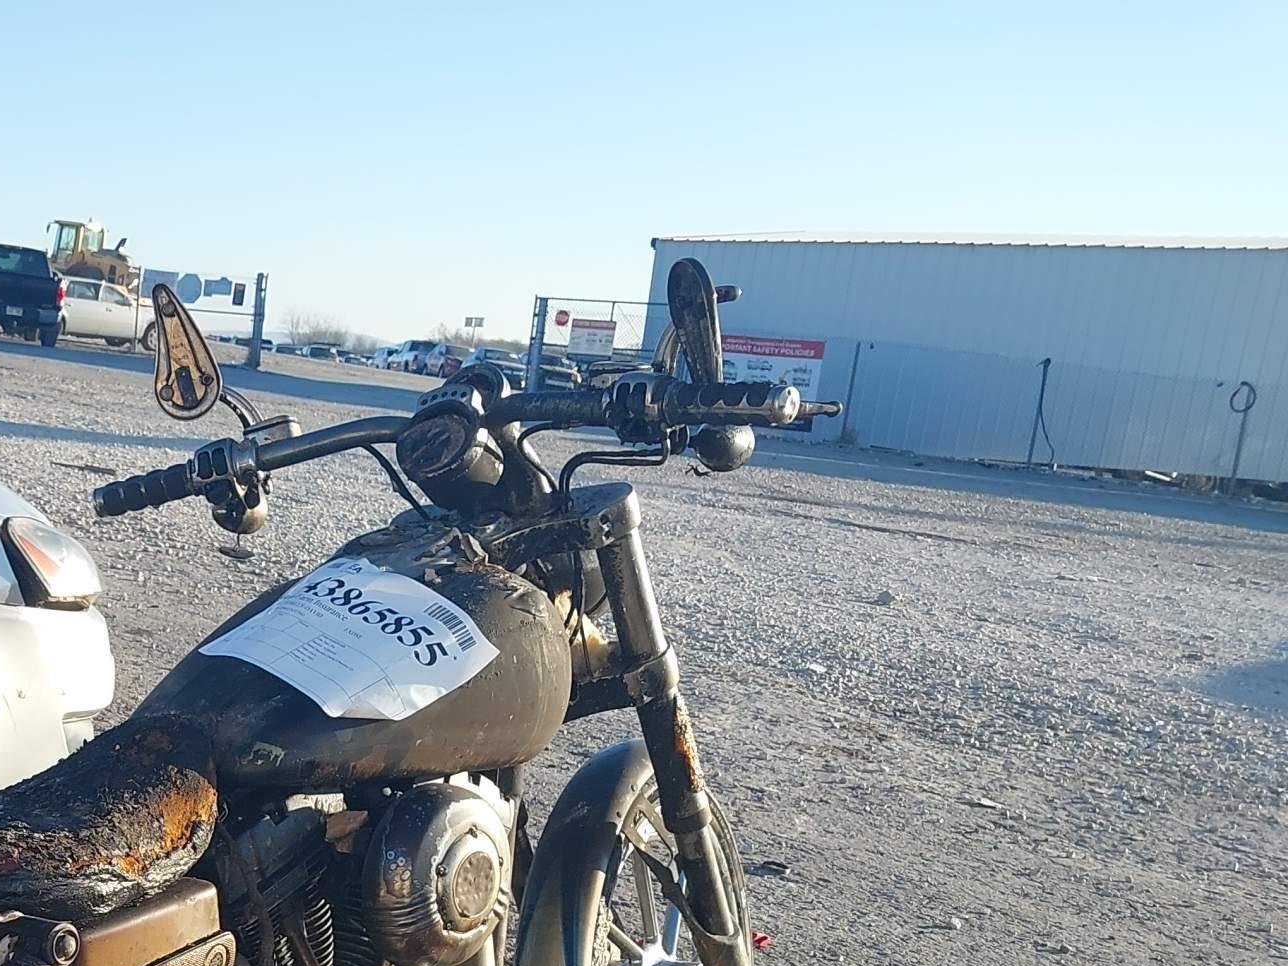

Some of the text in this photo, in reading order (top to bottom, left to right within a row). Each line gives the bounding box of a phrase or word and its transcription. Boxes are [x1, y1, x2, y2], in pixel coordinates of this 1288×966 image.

[722, 344, 815, 357] ORTANT SAFETY POLICIES
[303, 576, 450, 667] 43865855
[313, 599, 349, 622] Insurance
